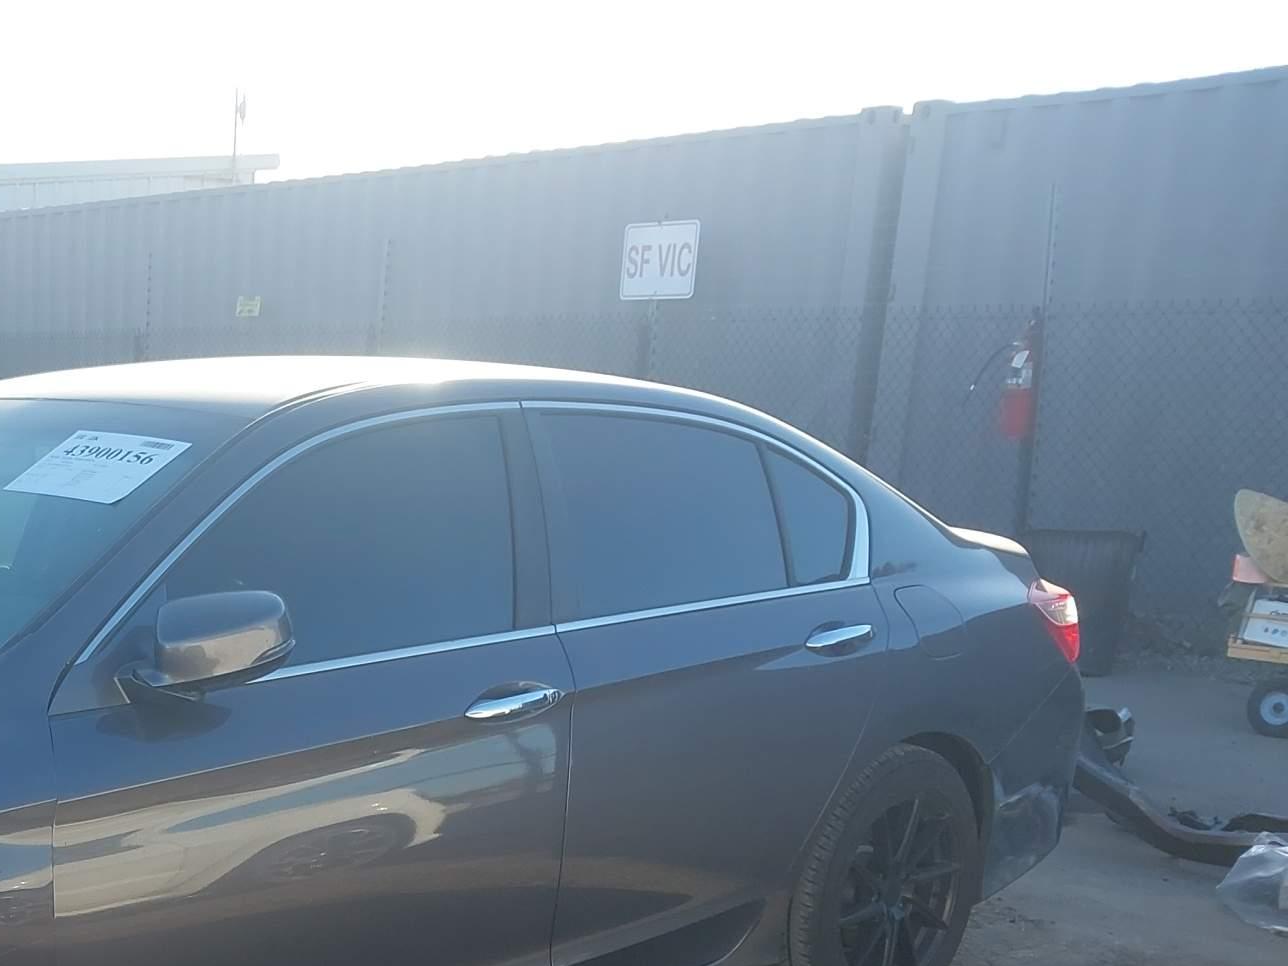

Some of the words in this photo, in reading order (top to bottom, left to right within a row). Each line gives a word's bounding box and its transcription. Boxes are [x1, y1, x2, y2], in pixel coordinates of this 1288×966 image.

[626, 244, 652, 279] SF
[658, 242, 693, 278] VIC
[64, 444, 158, 465] 43900156
